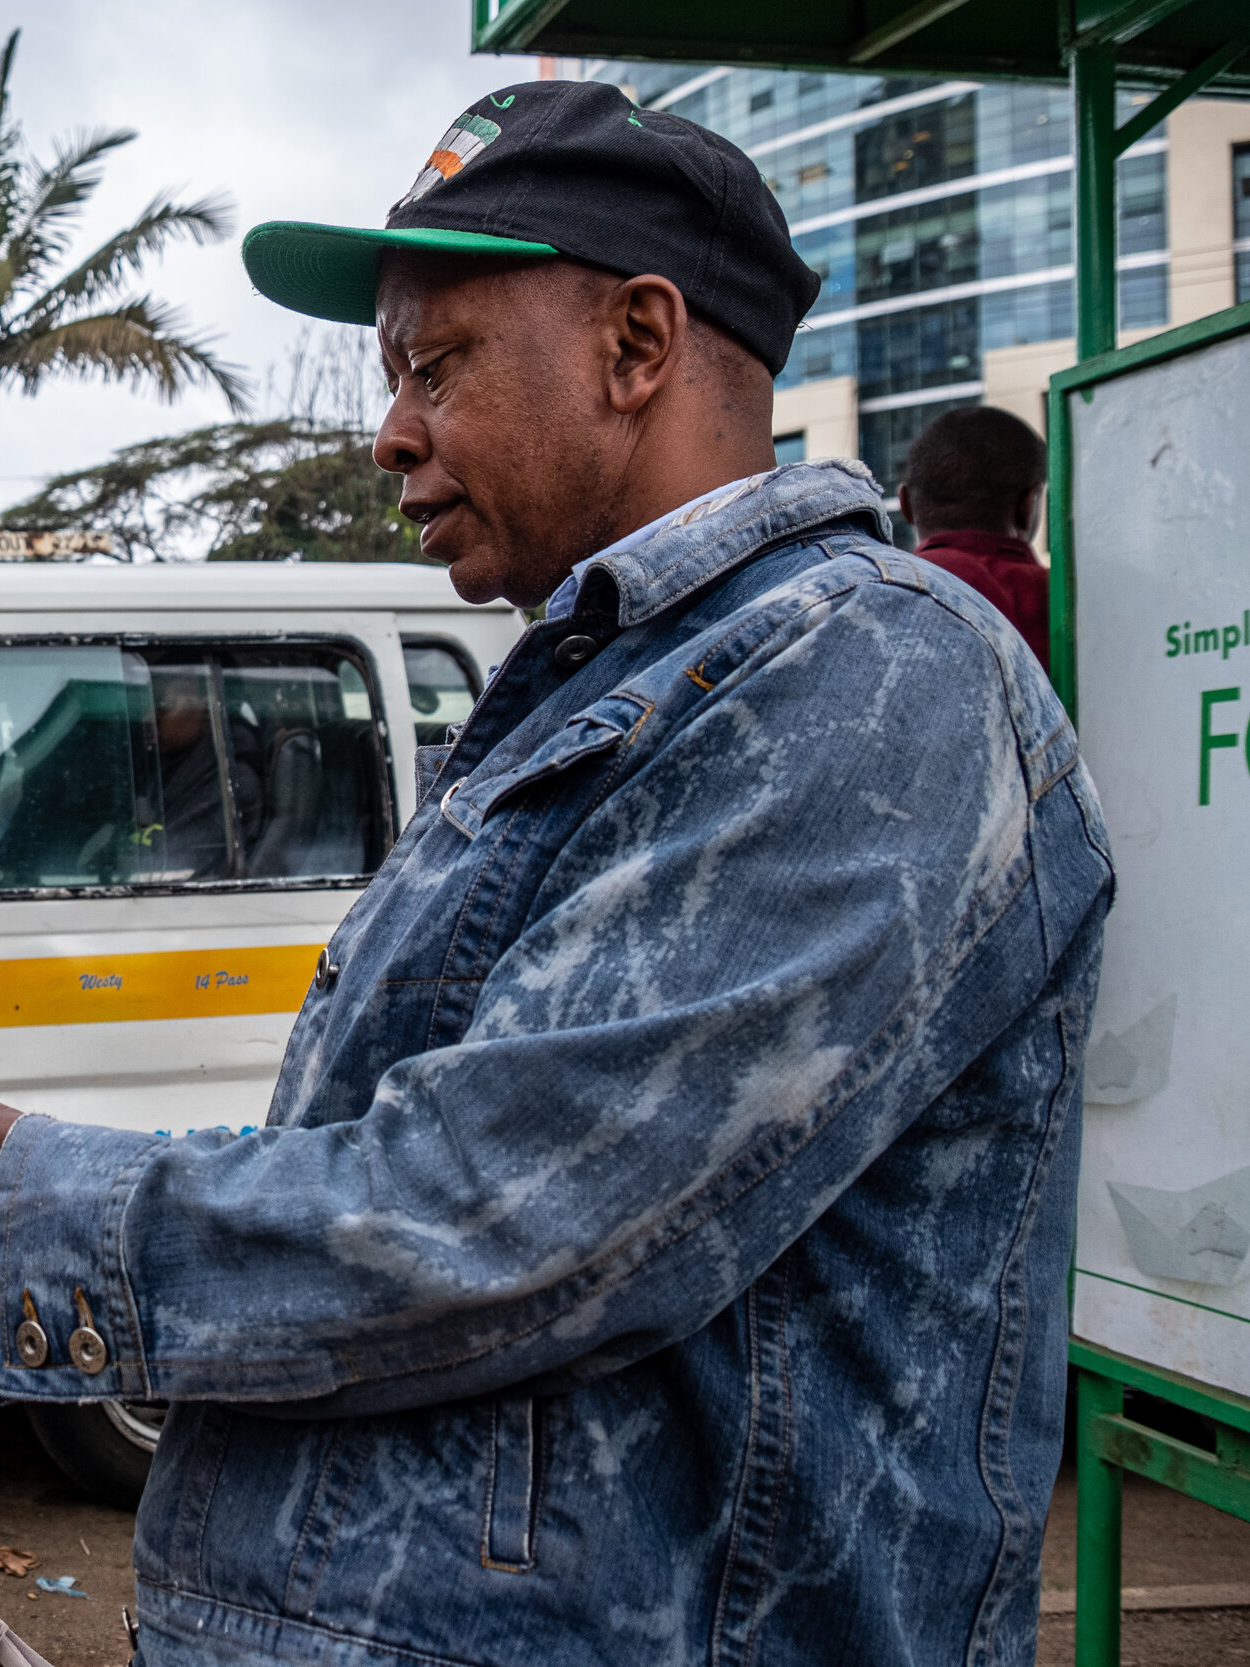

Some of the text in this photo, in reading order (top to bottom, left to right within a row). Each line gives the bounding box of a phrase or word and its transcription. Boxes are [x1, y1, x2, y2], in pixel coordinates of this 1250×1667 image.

[1199, 686, 1250, 806] F
[80, 973, 123, 991] Westy
[195, 970, 249, 990] 14 Pass
